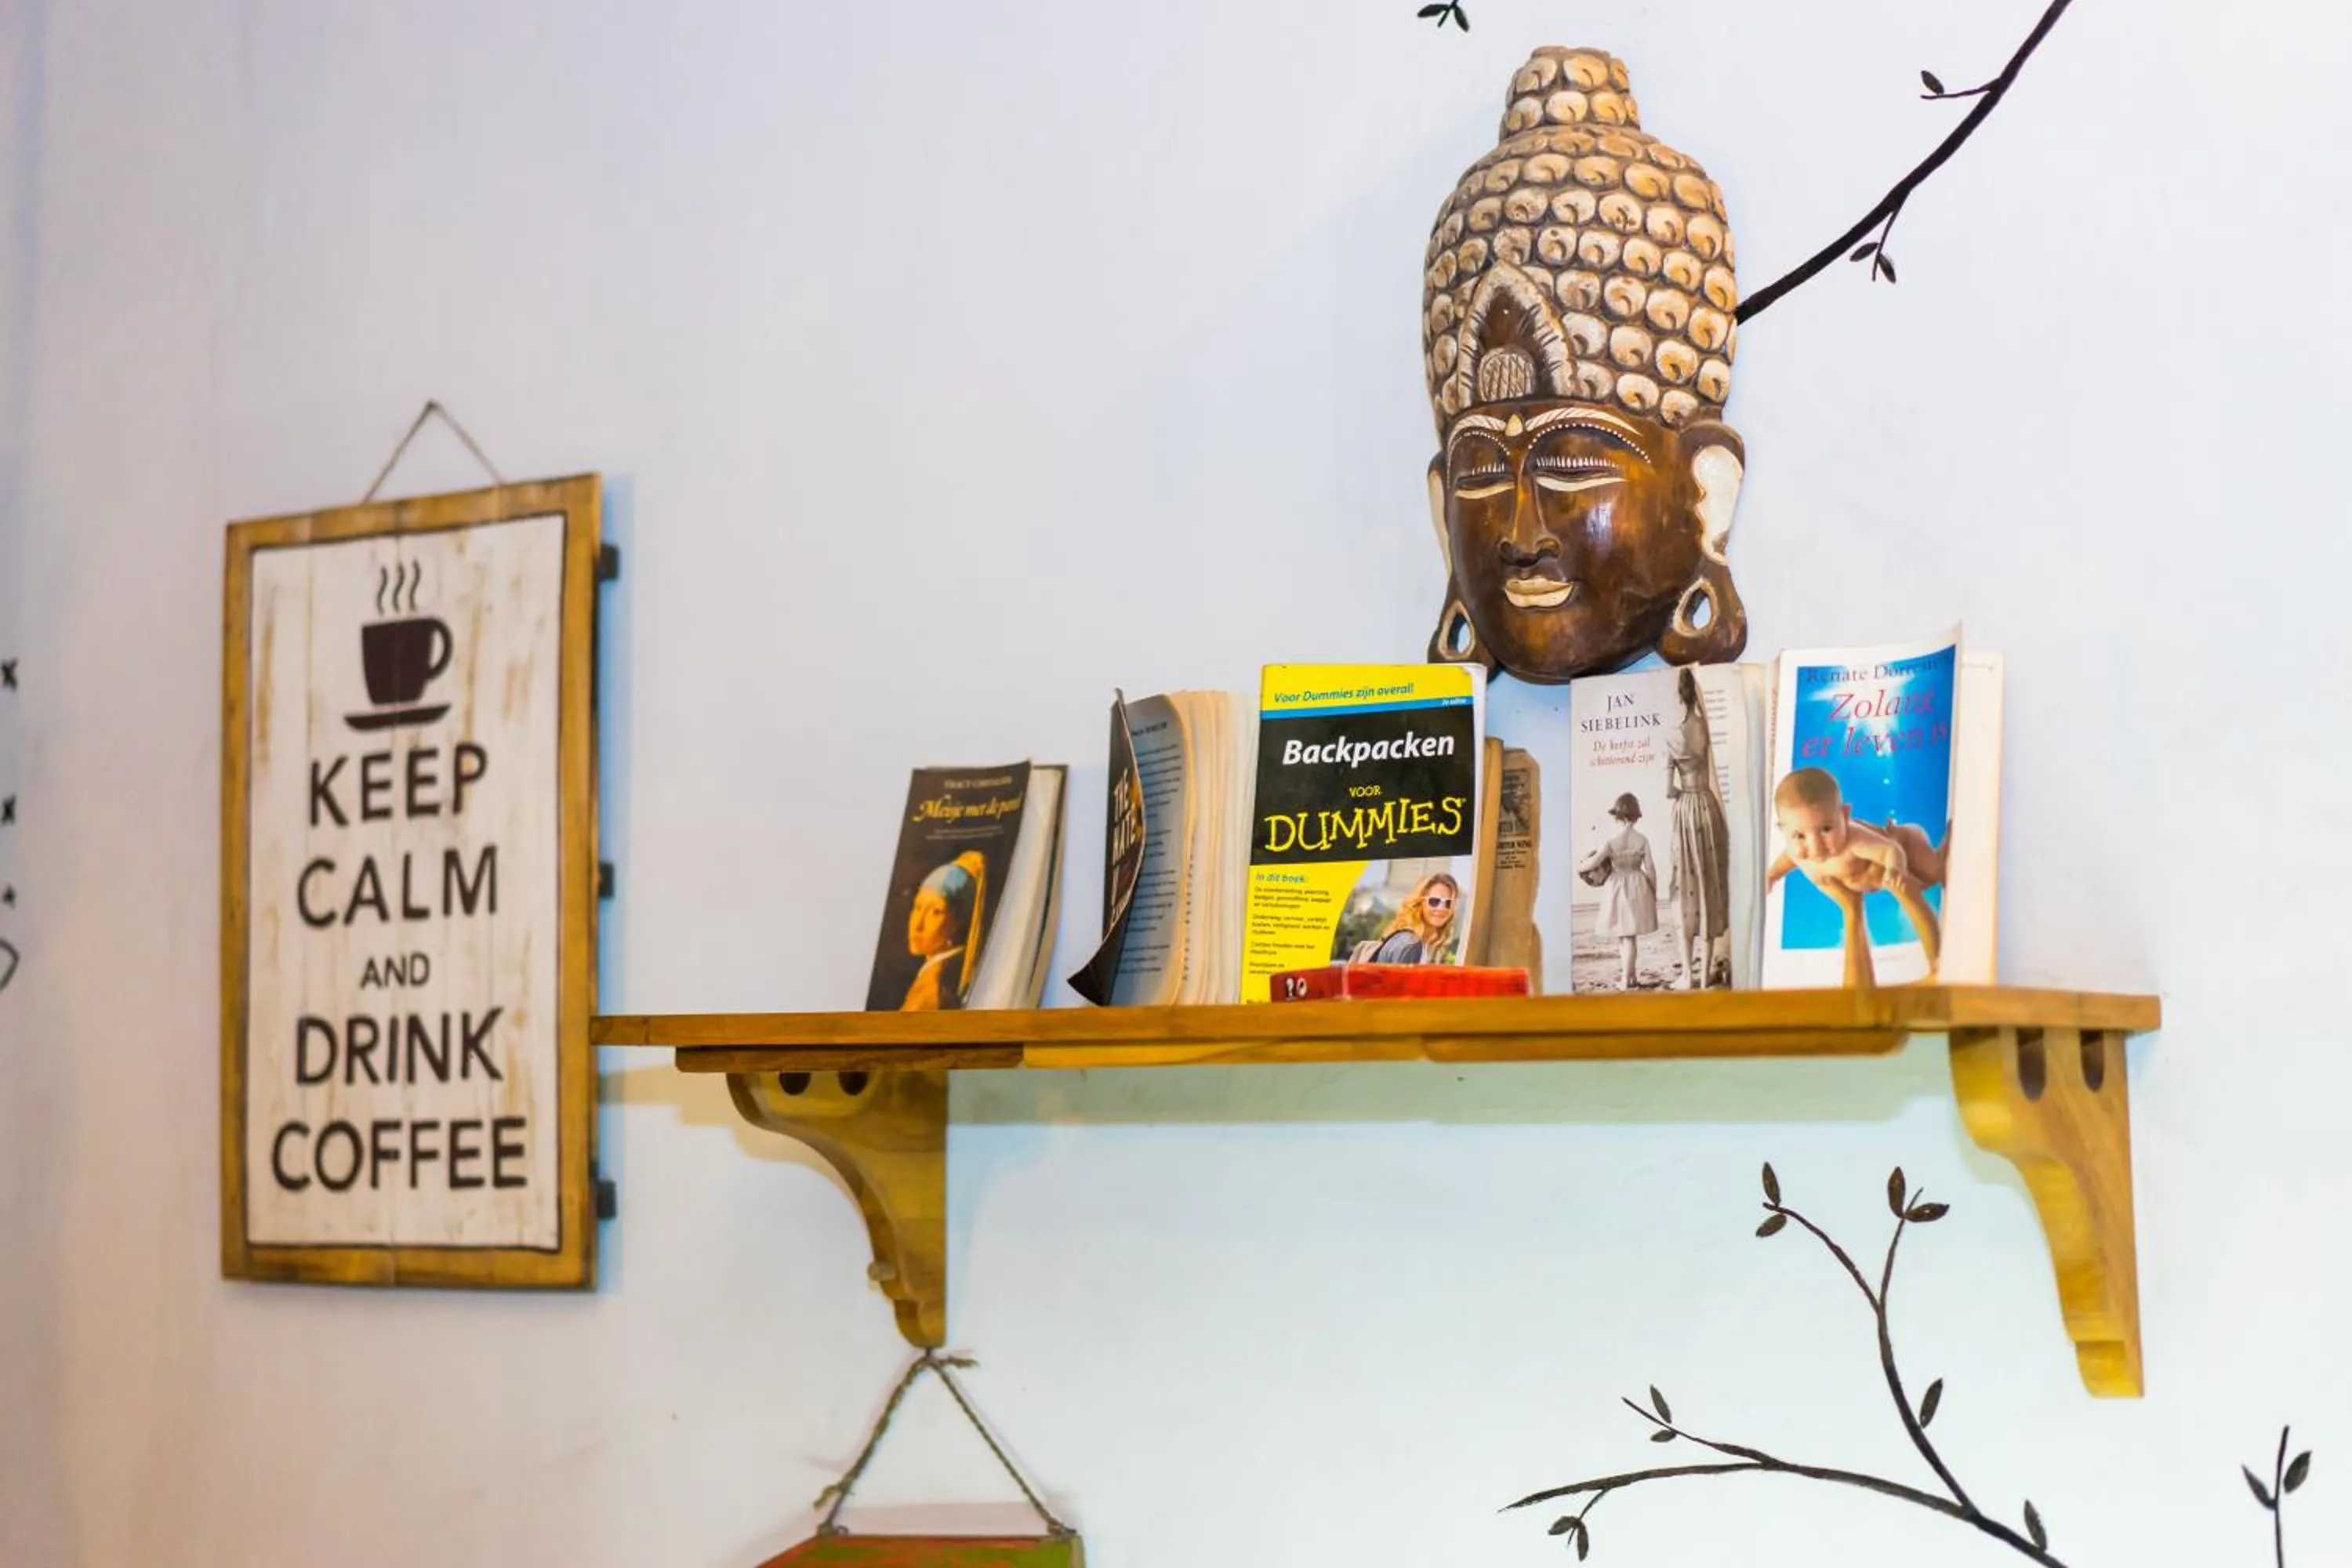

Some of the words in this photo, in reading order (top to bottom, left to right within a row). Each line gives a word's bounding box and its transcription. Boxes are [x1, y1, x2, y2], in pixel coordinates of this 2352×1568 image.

[1273, 692, 1300, 704] Voor
[1301, 689, 1354, 702] Dummies
[1356, 687, 1375, 700] zijn
[1607, 693, 1635, 713] JAN
[1830, 689, 1934, 720] Zolang
[1581, 713, 1661, 733] SIEBELINK
[1801, 735, 1832, 757] er
[1843, 725, 1923, 757] leven
[1283, 731, 1455, 769] Backpacken
[309, 741, 488, 829] KEEP
[1348, 785, 1382, 797] VOOR
[1263, 797, 1464, 852] DUMMIES
[296, 843, 499, 928] CALM
[359, 951, 430, 991] AND
[295, 1006, 505, 1088] DRINK
[271, 1116, 529, 1194] COFFEE
